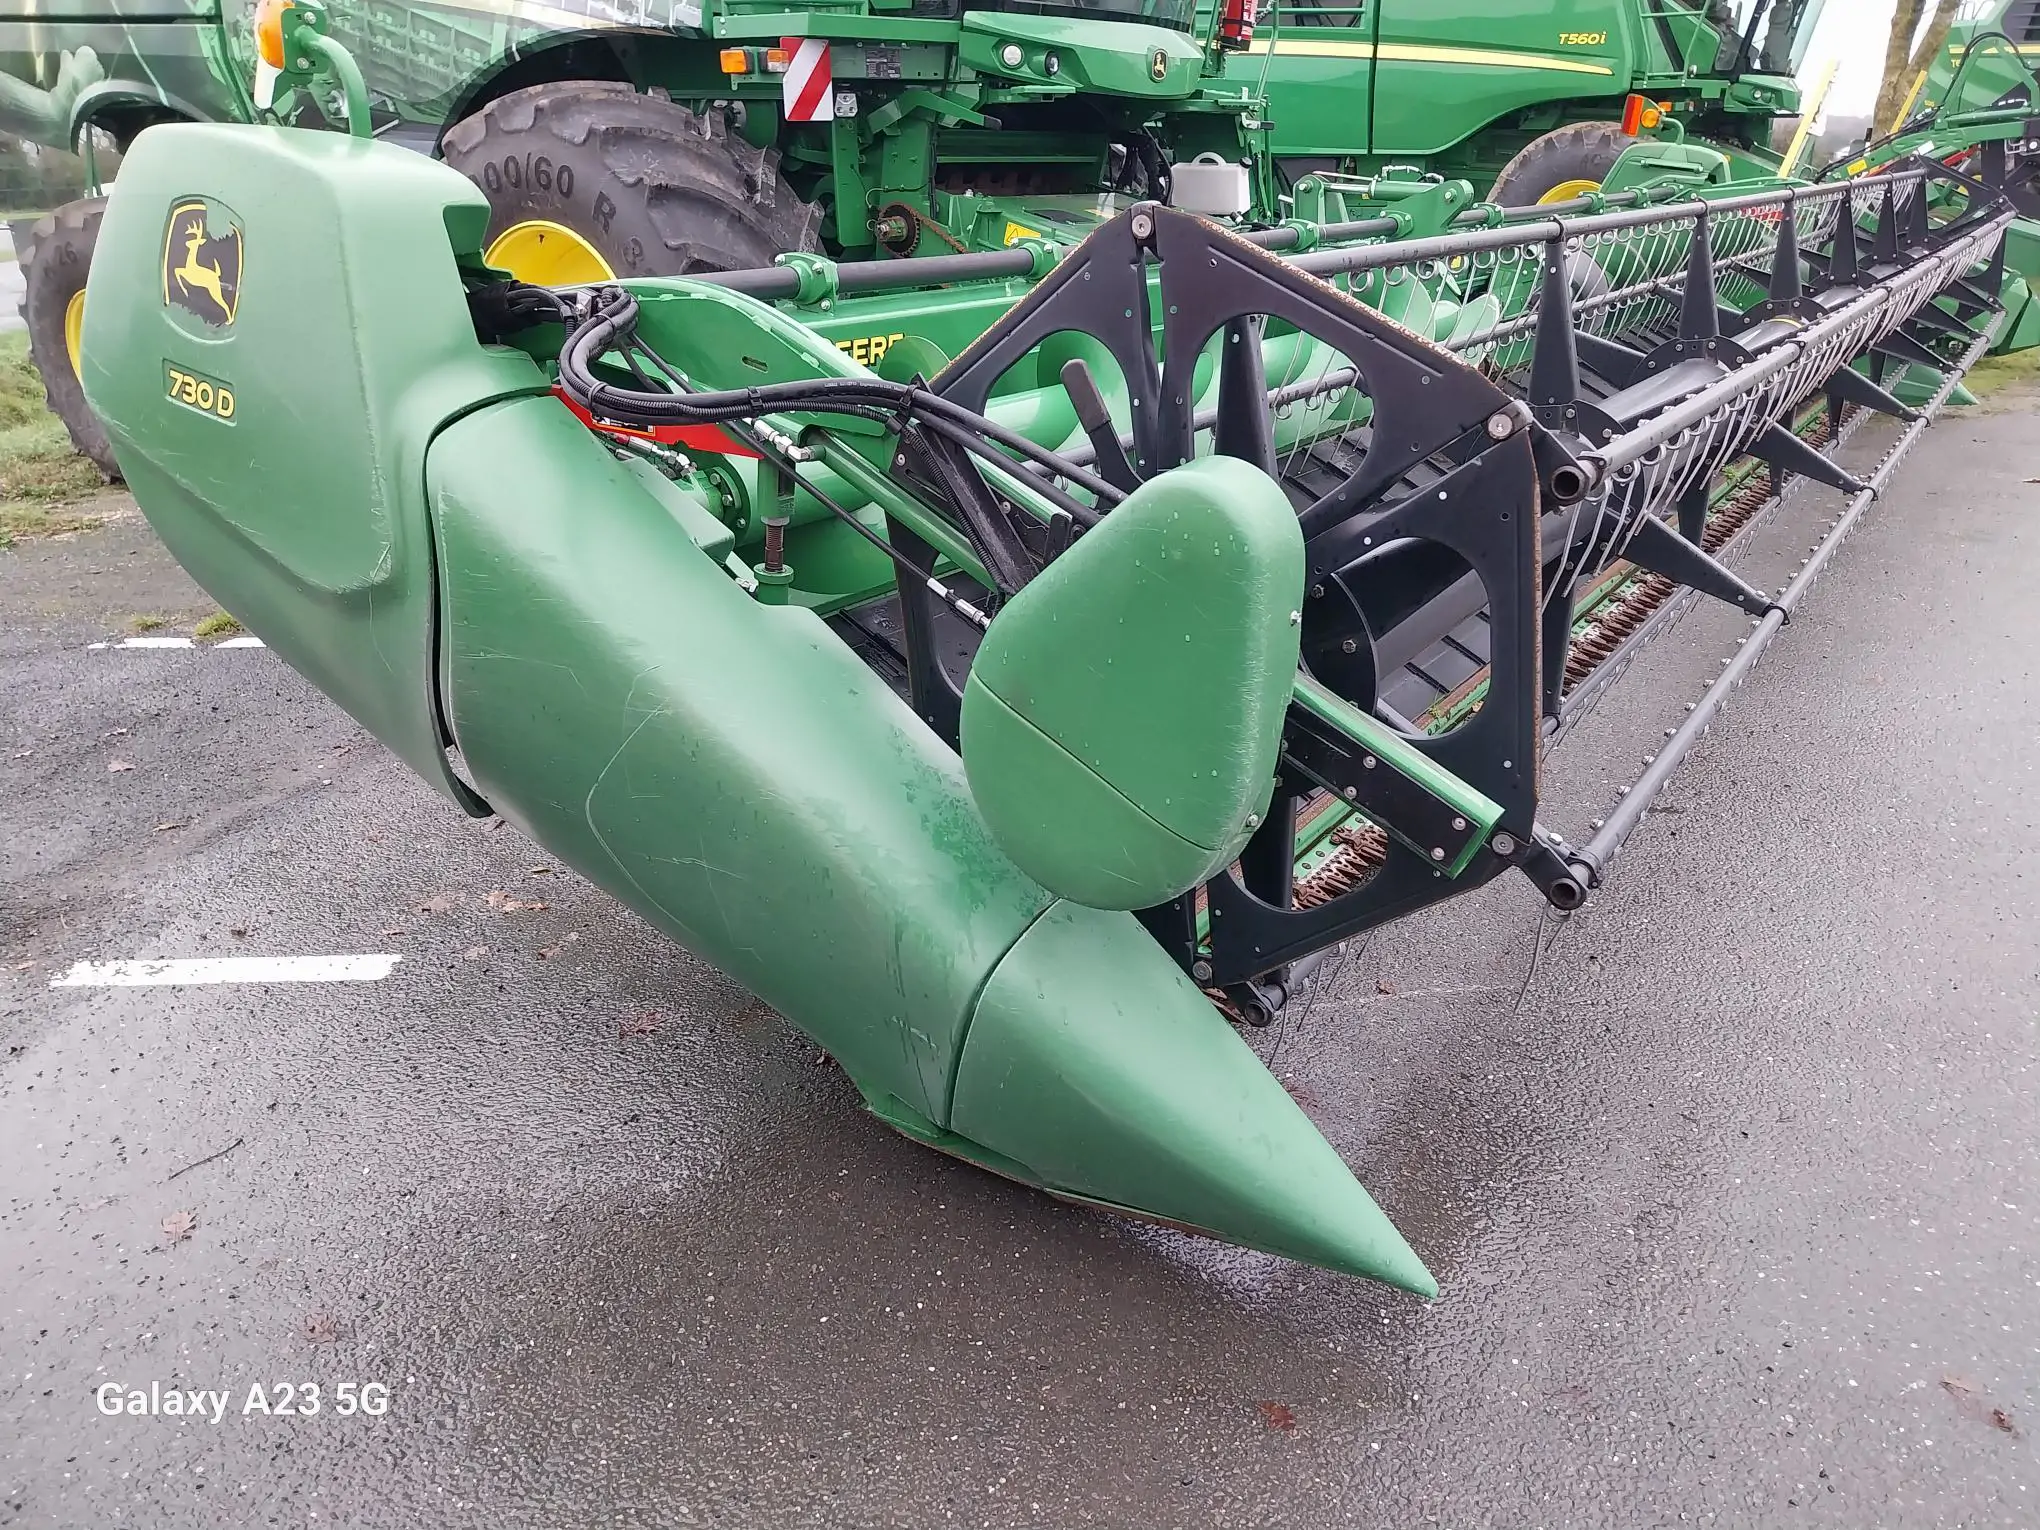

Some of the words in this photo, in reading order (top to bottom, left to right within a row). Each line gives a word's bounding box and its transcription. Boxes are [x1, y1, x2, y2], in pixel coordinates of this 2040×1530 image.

[1558, 31, 1607, 45] T560i
[169, 368, 214, 410] 730
[216, 387, 235, 418] D
